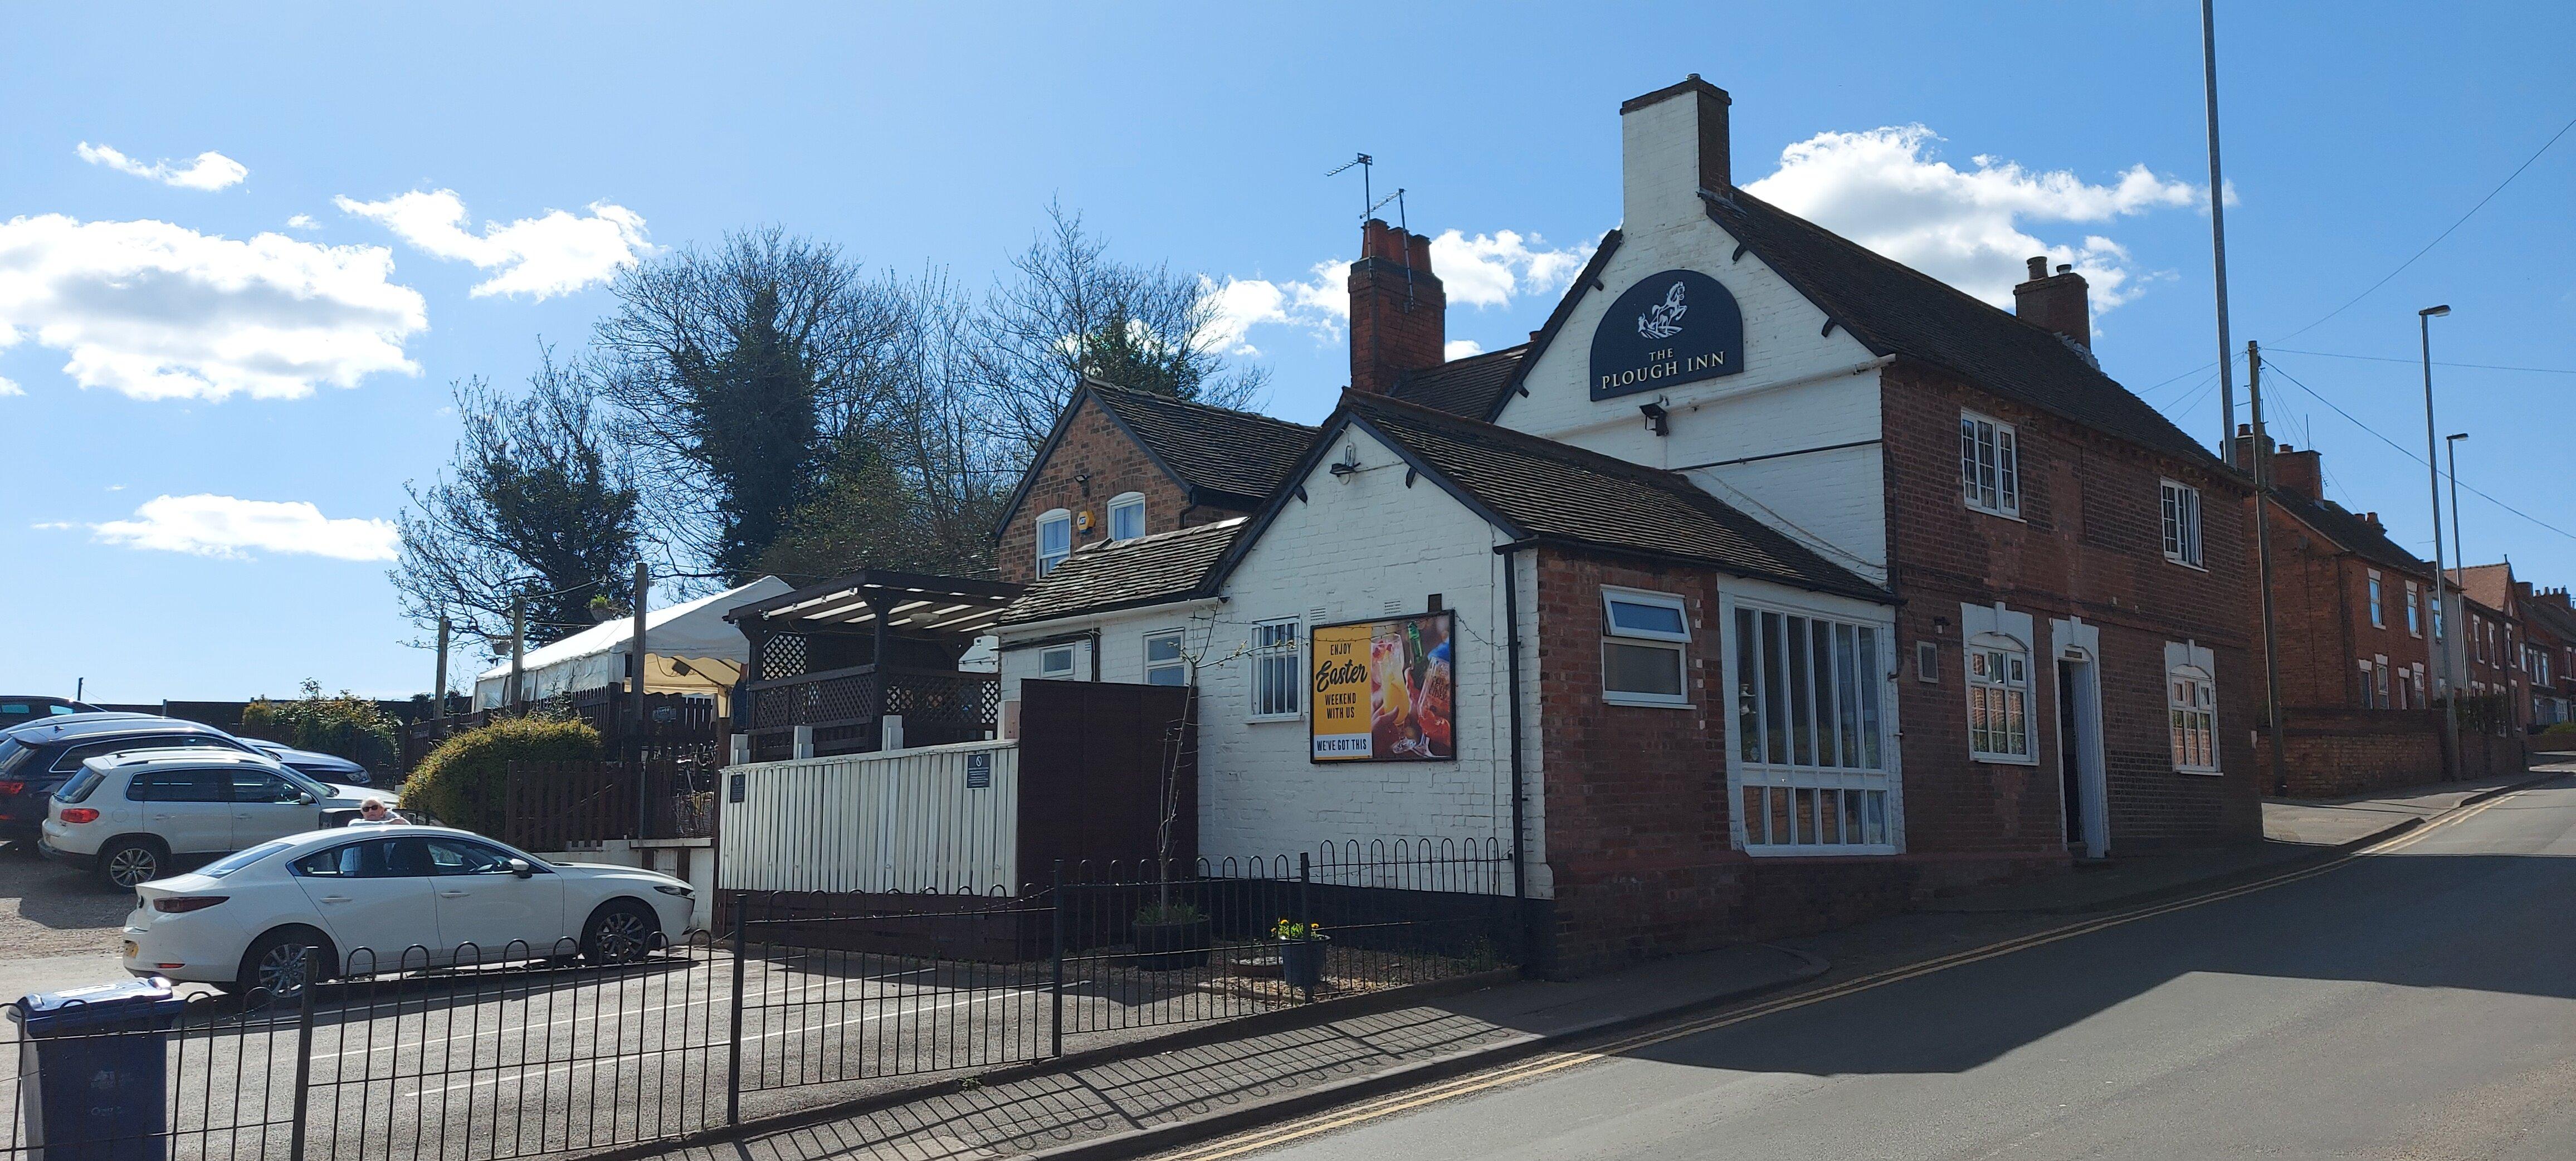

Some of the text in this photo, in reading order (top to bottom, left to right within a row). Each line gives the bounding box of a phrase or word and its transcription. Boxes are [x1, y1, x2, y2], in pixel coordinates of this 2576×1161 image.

[1649, 348, 1674, 361] THE
[1602, 351, 1724, 389] PLOUGH INN
[1330, 643, 1352, 655] ENJOY
[1316, 659, 1368, 692] Easter
[1325, 692, 1356, 705] WEEKEND
[1326, 706, 1354, 719] WITH US
[1317, 739, 1367, 751] WE'VE GOT THIS
